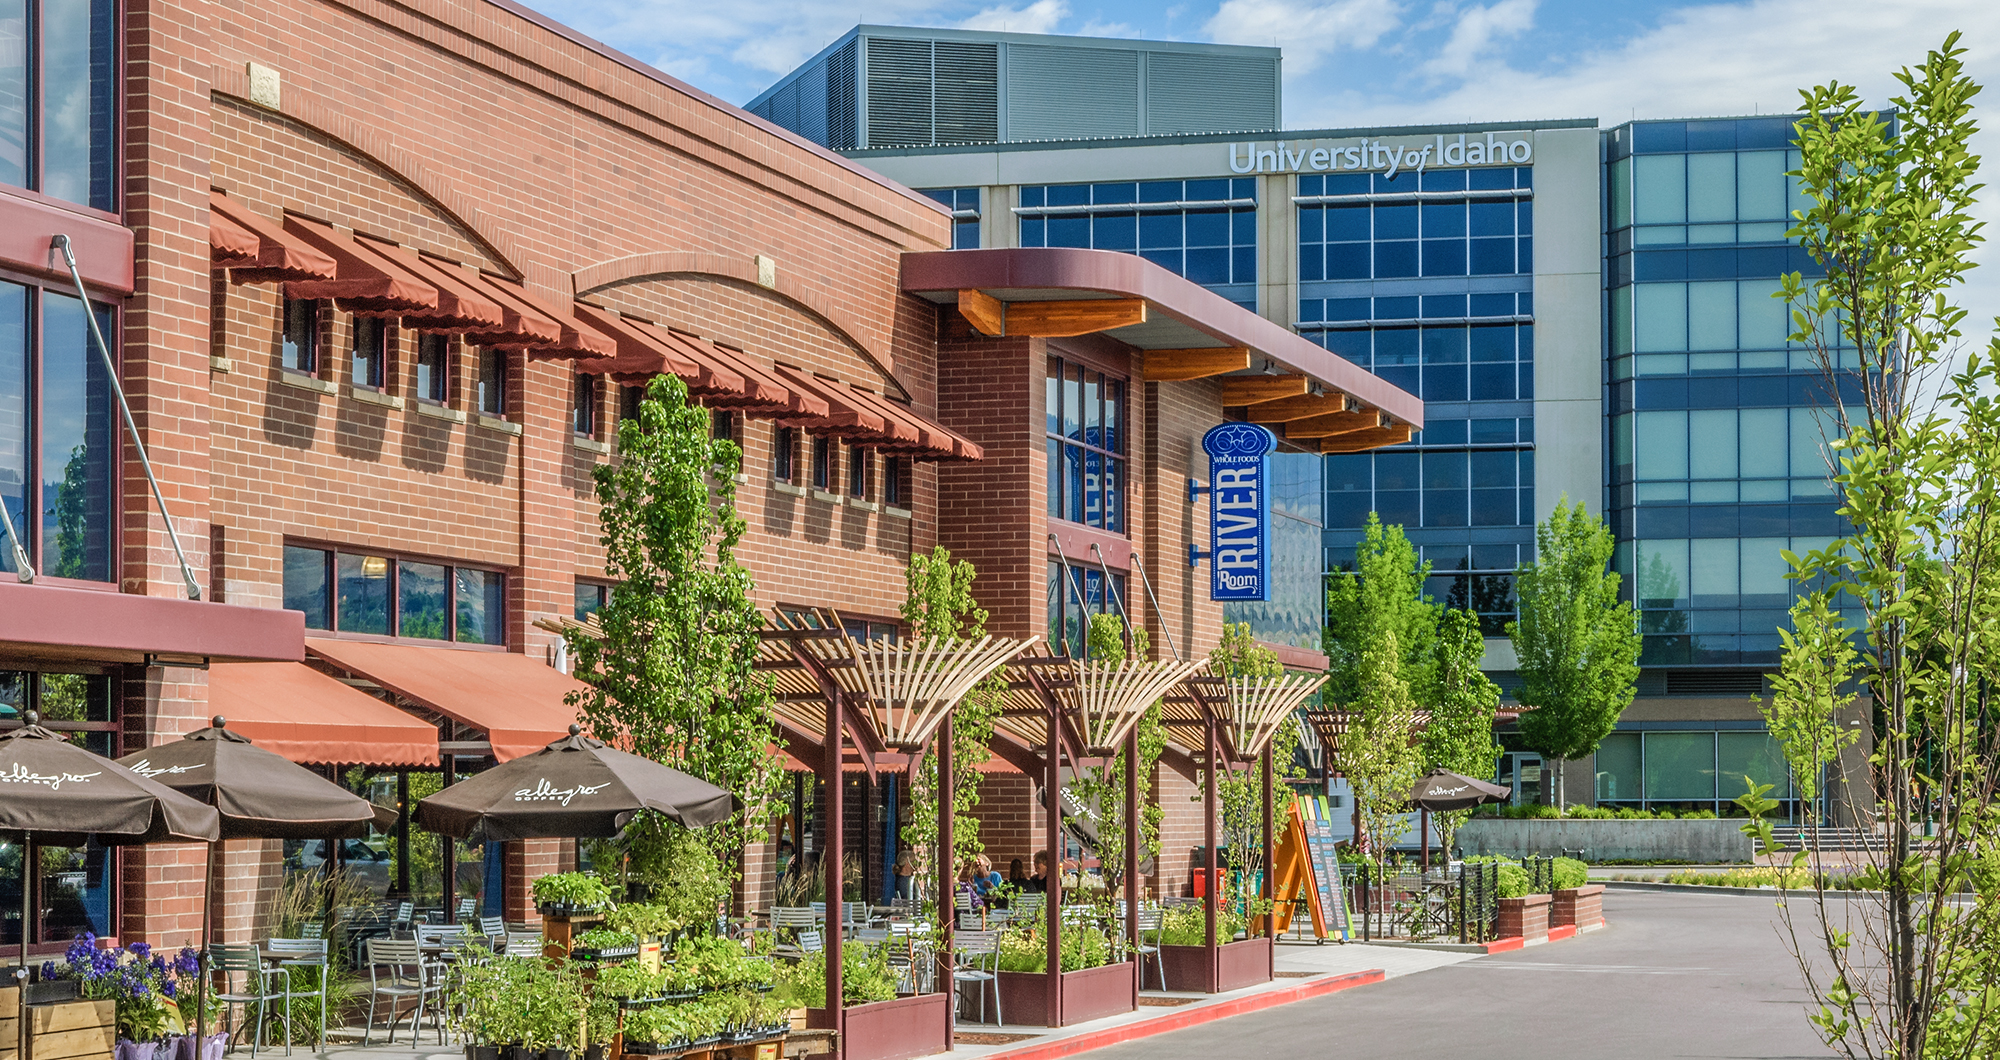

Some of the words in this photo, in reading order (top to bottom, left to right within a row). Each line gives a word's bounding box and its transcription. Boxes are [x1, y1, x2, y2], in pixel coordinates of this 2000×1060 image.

[1229, 138, 1404, 179] University
[1404, 144, 1434, 172] of
[1436, 133, 1532, 166] Idaho
[1214, 454, 1238, 464] WHOLE
[1238, 455, 1260, 463] FOODS
[1216, 466, 1258, 570] RIVER
[1217, 570, 1258, 595] Room
